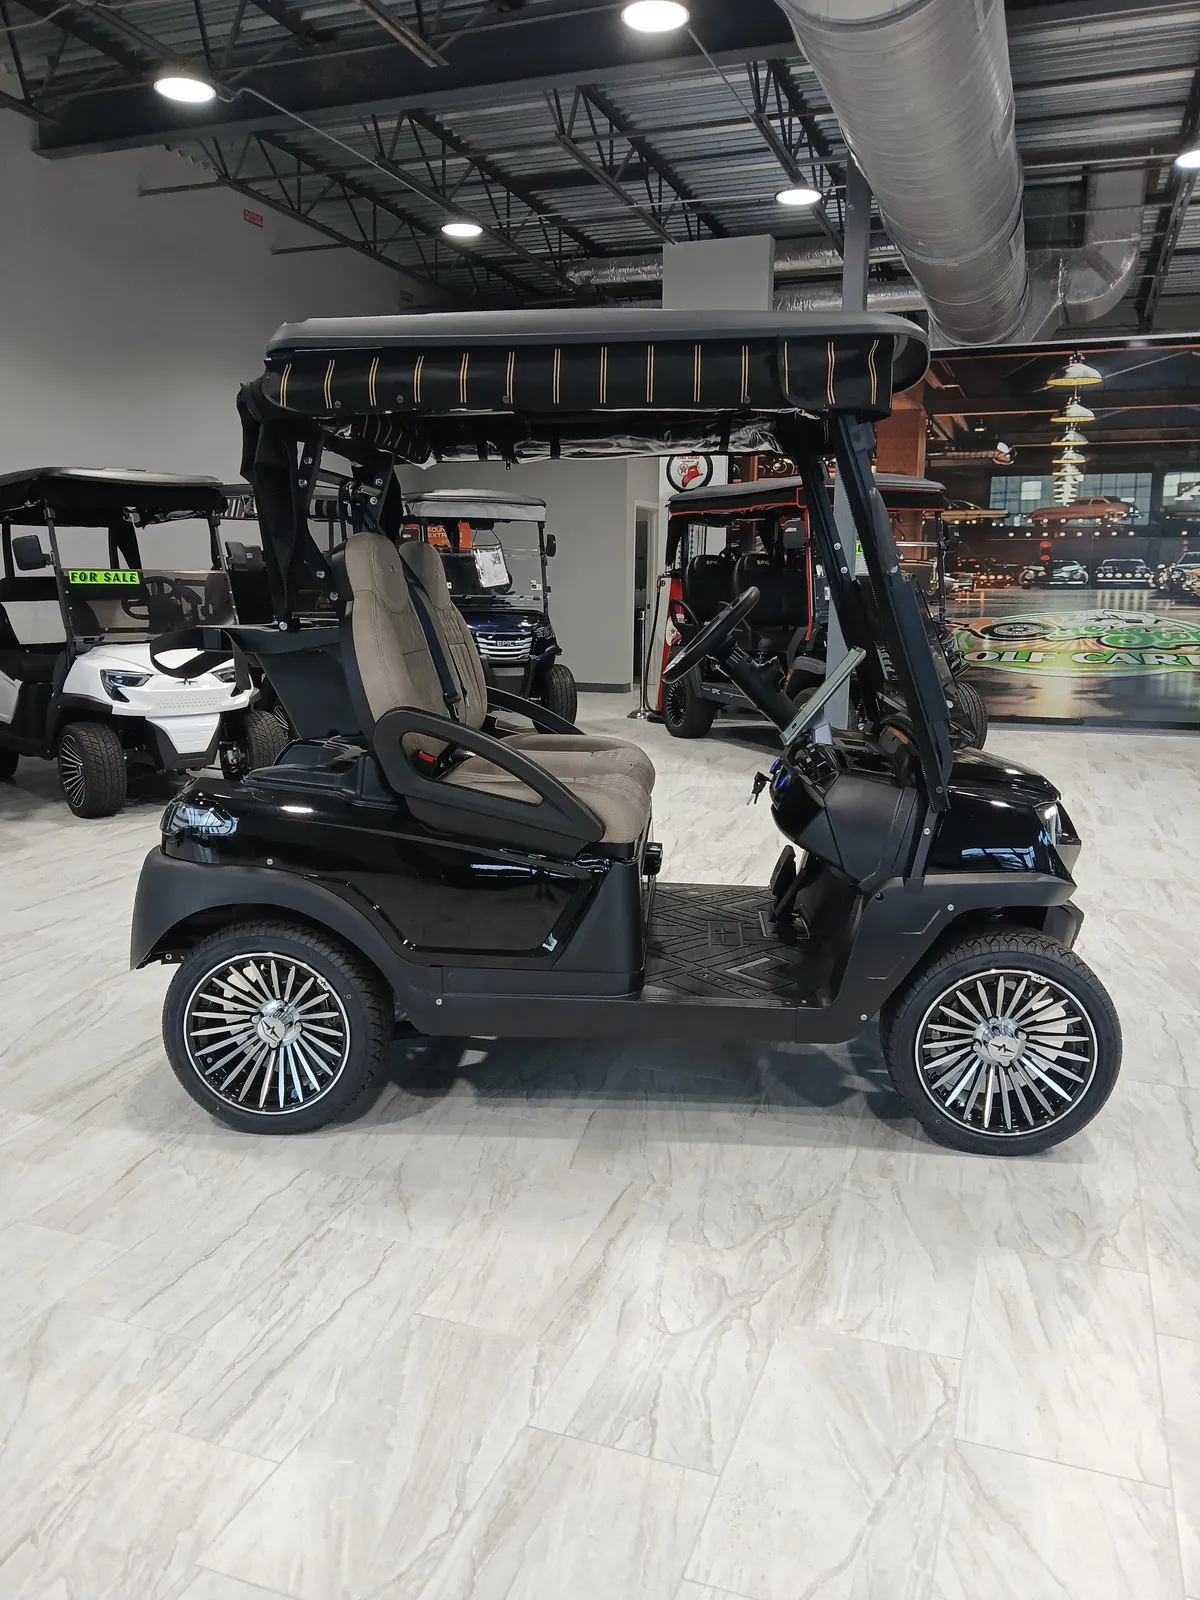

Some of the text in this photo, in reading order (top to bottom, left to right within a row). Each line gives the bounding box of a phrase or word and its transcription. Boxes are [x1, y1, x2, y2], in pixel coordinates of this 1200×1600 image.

[71, 572, 137, 583] FOR SALE
[959, 650, 1060, 663] OLF
